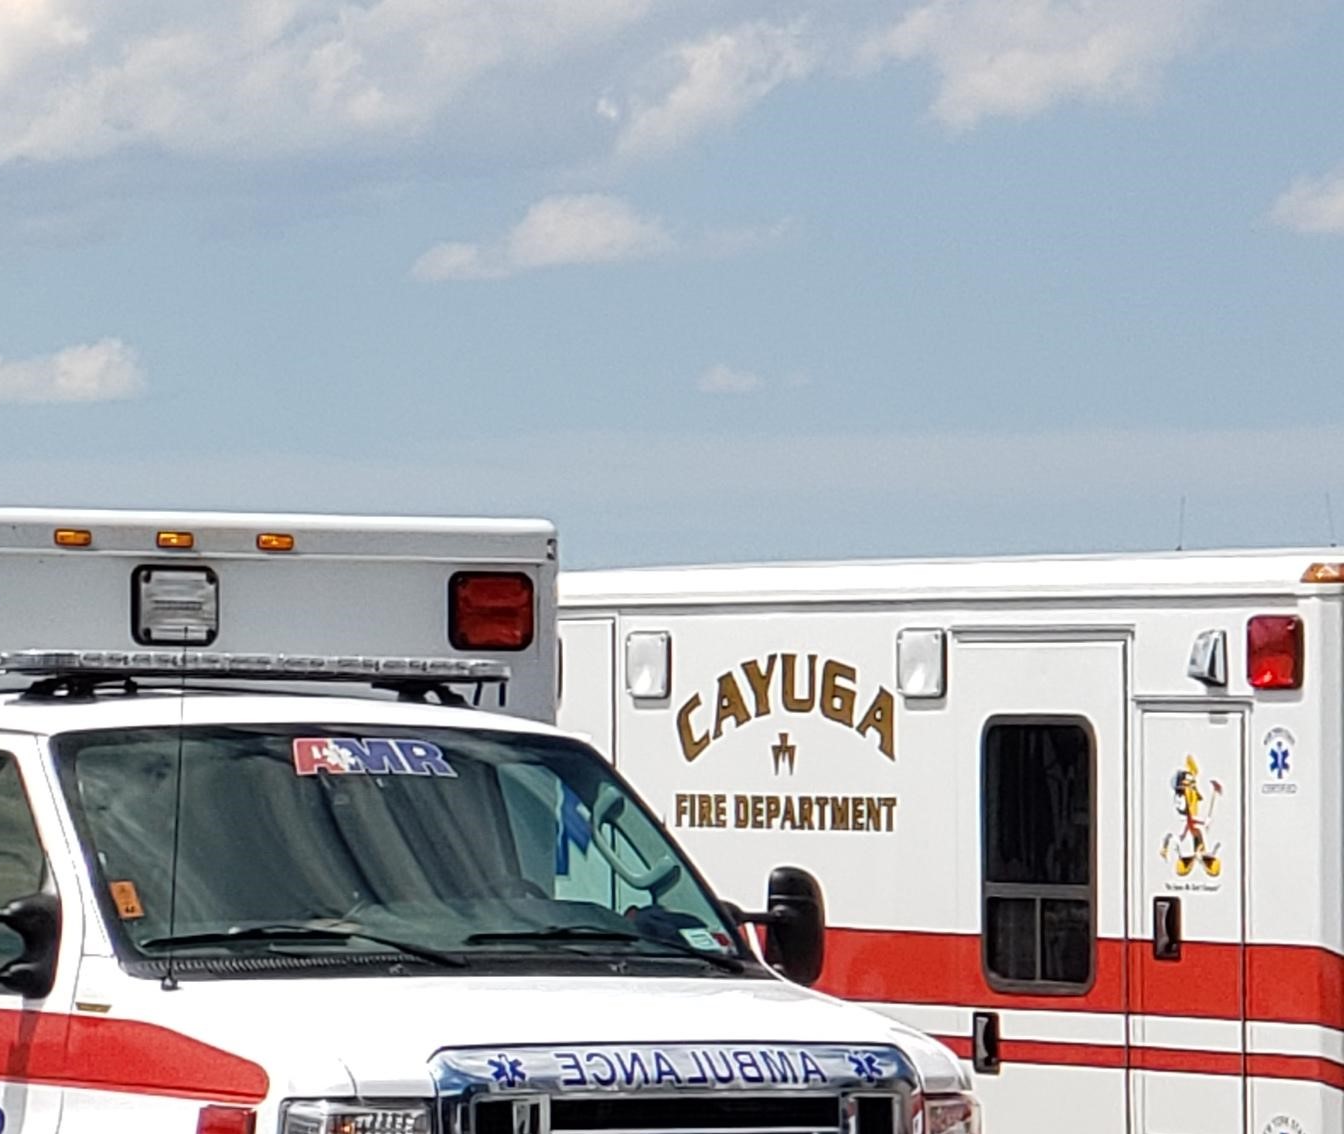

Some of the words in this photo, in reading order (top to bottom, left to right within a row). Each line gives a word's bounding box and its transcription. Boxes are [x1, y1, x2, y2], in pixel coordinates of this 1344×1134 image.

[675, 652, 896, 763] CAYUGA
[293, 737, 459, 778] AMR
[674, 793, 728, 828] FIRE
[733, 794, 898, 833] DEPARTMENT
